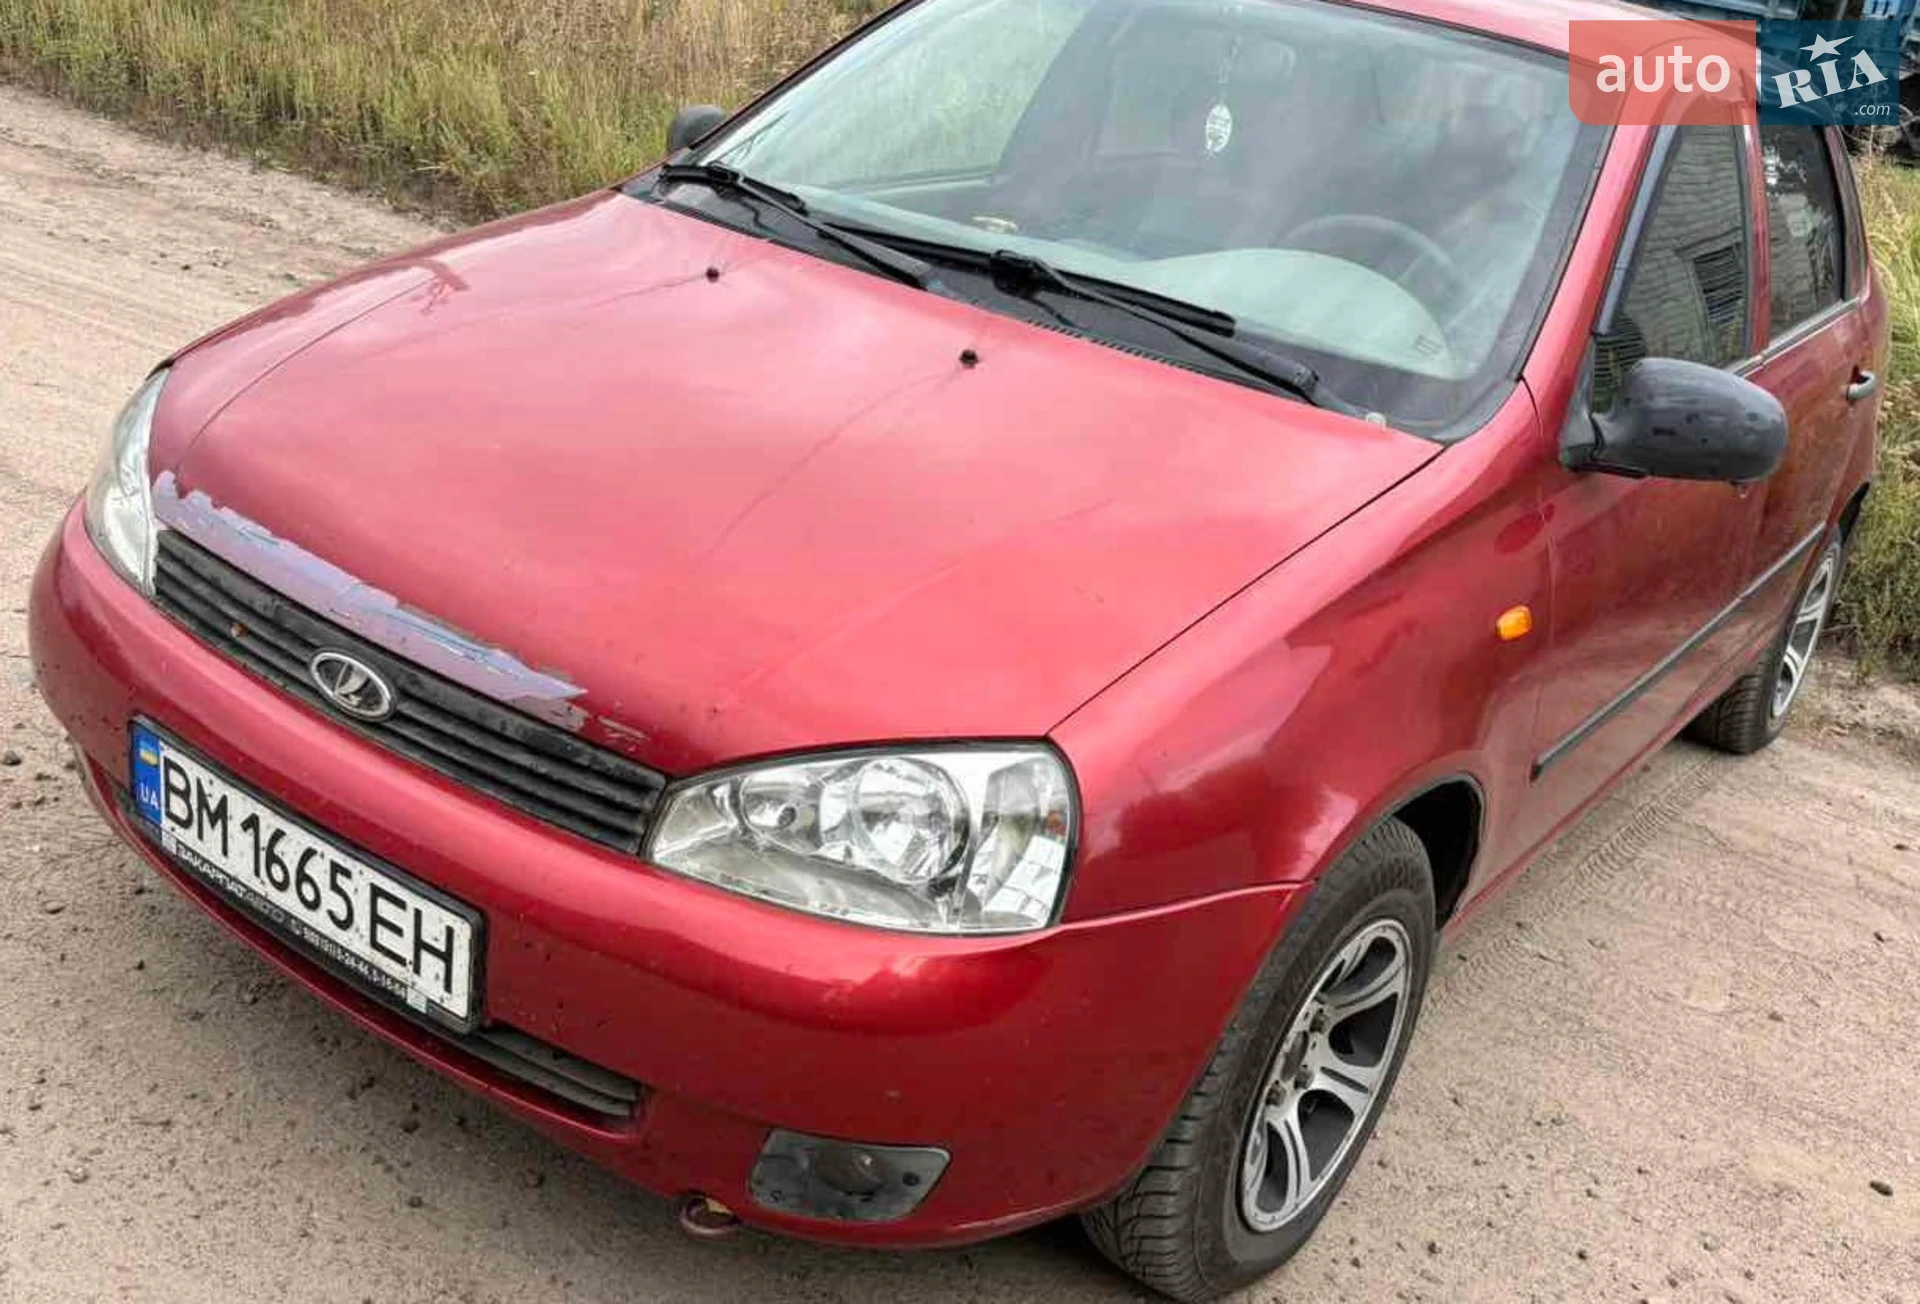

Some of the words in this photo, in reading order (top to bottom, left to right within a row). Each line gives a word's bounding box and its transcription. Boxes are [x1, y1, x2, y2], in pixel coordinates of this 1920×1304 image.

[140, 782, 159, 809] UA
[163, 756, 229, 857] BM
[240, 812, 354, 932] 1665
[369, 882, 455, 995] EH
